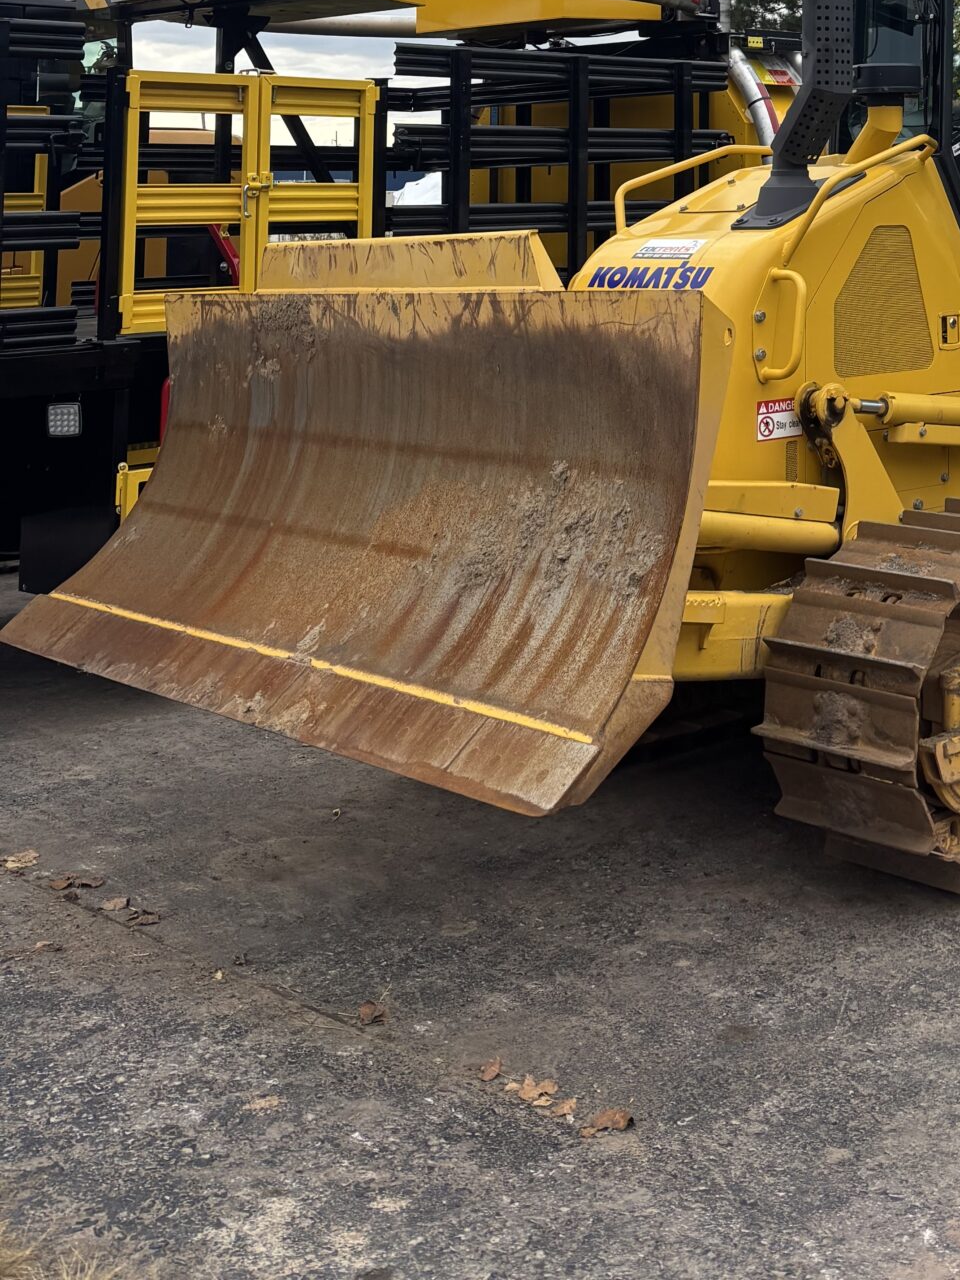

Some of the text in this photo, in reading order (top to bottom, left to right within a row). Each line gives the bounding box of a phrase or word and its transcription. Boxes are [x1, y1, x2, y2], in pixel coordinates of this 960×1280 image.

[587, 261, 715, 289] KOMATSU
[768, 400, 795, 413] DANGE
[776, 419, 800, 431] Stay clea
